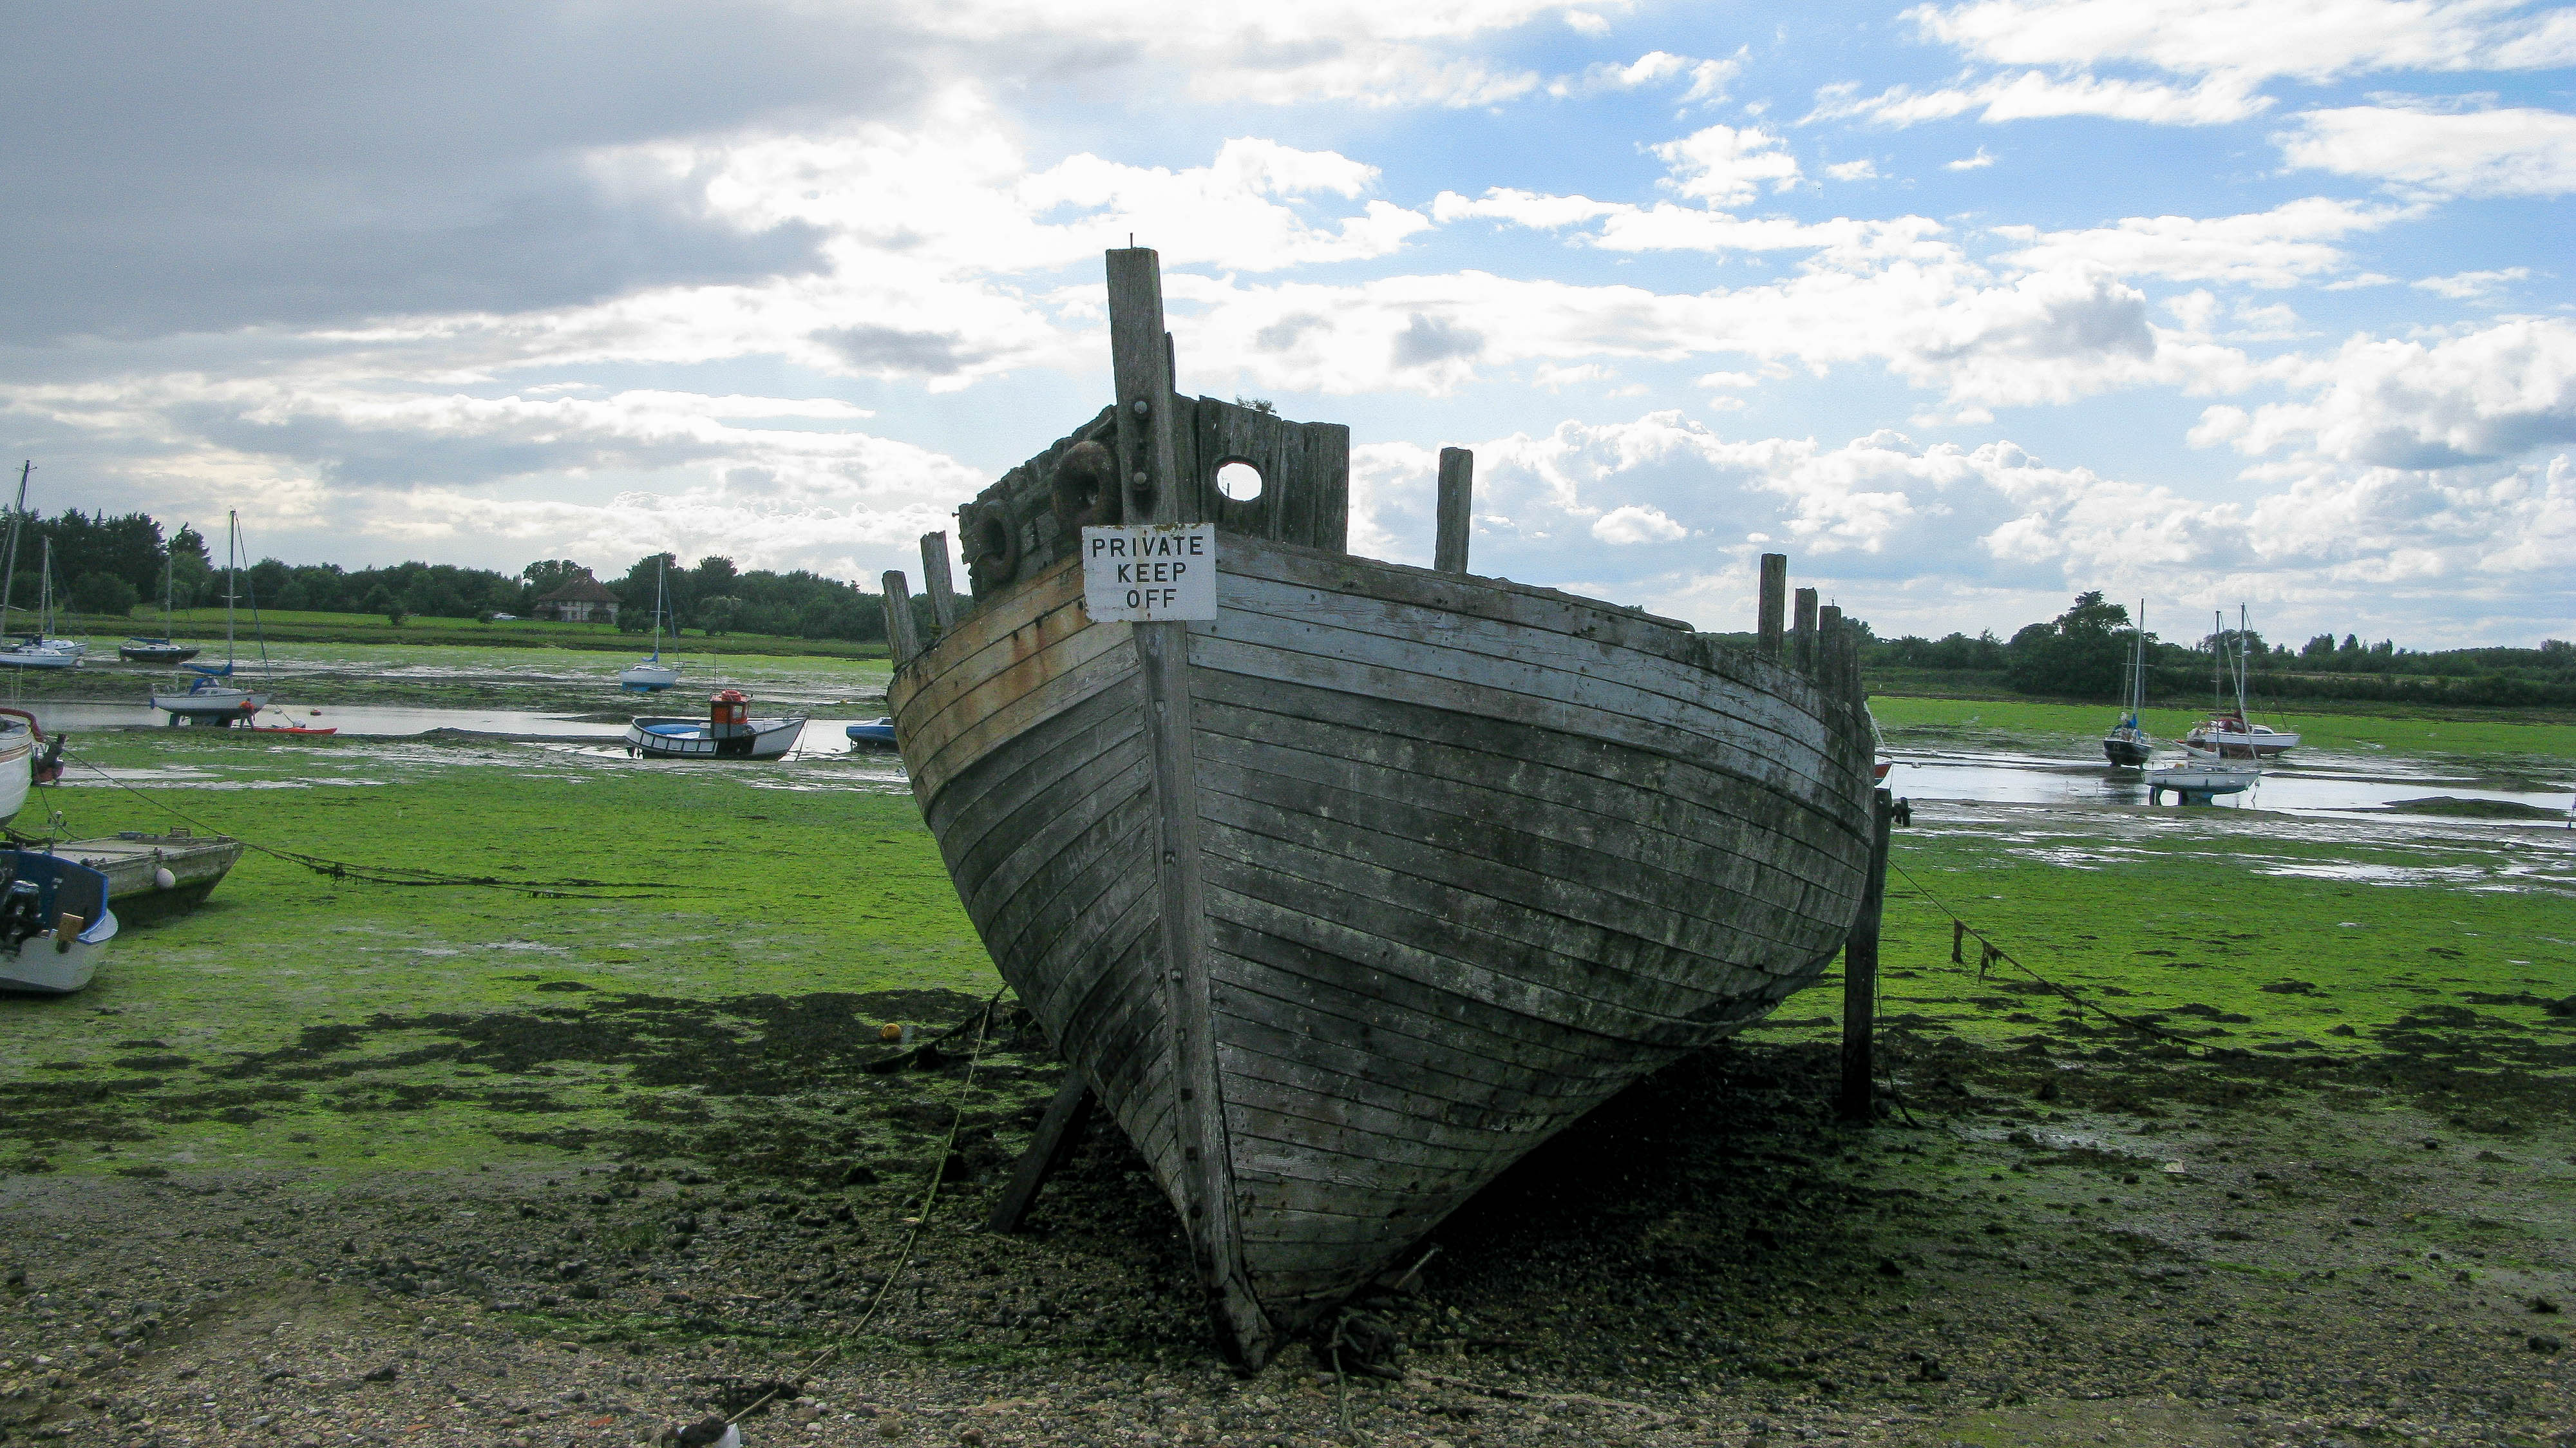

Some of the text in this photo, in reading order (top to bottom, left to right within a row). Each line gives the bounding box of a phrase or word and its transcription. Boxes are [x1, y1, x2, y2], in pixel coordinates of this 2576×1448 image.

[1092, 536, 1203, 557] PRIVATE
[1117, 562, 1186, 583] KEEP
[1126, 589, 1177, 608] OFF
